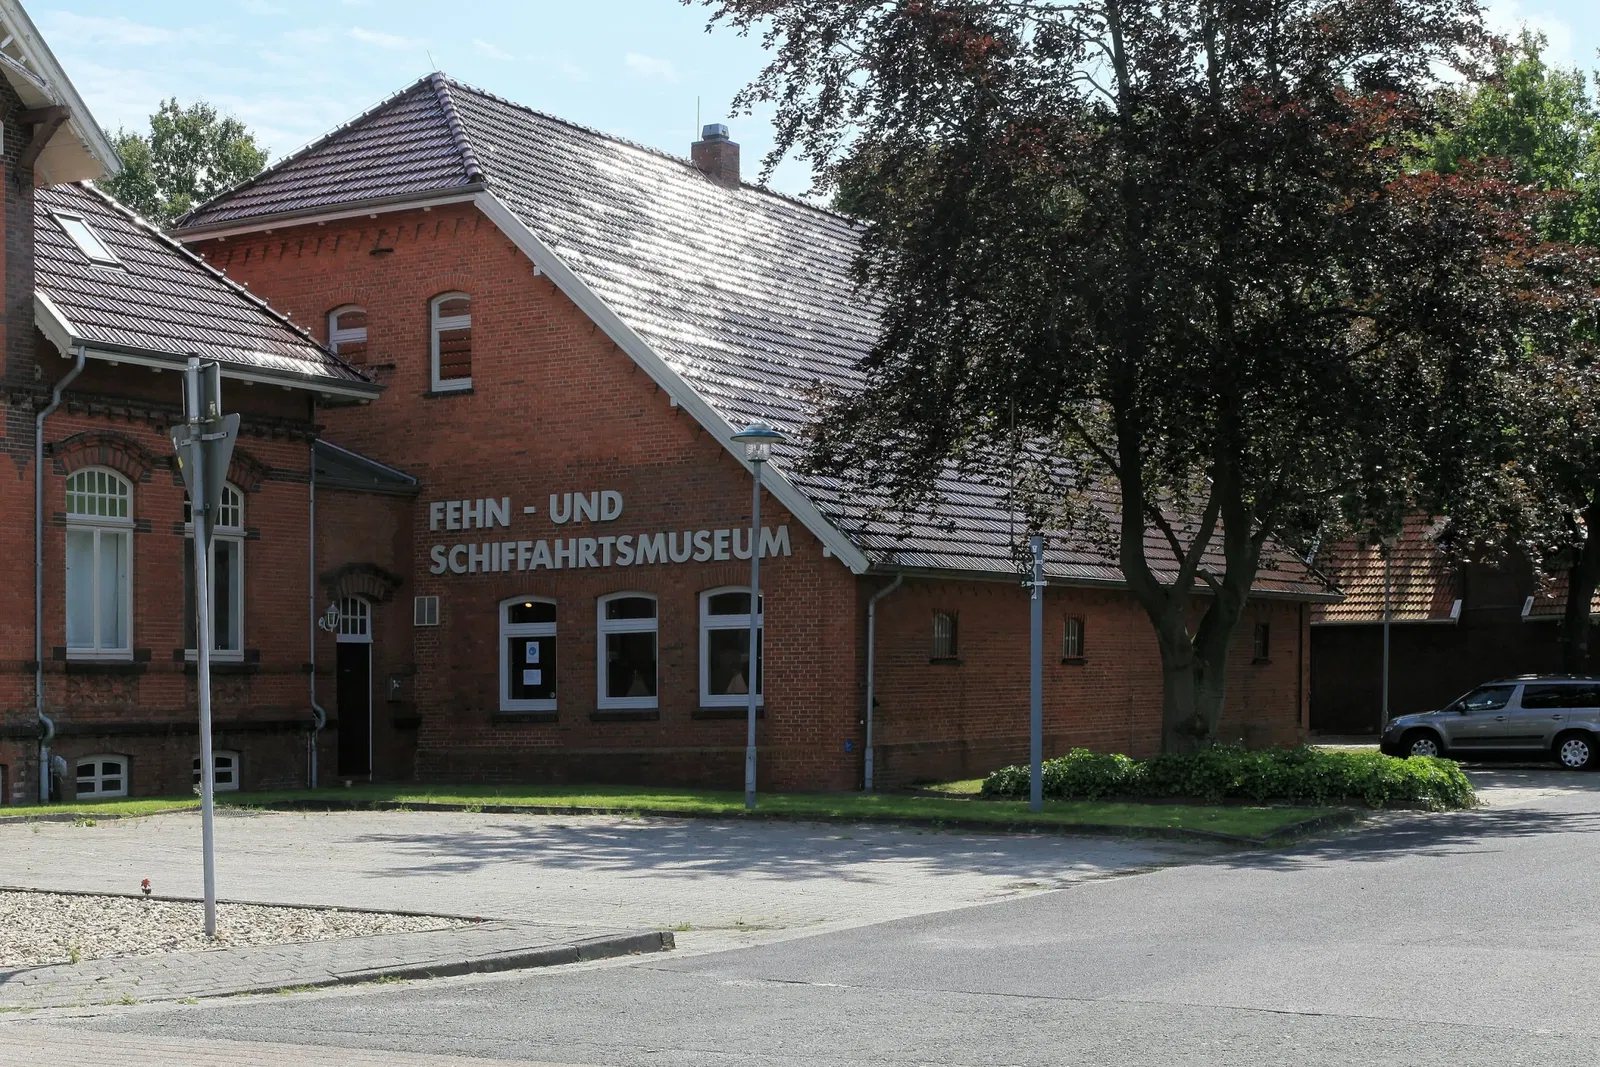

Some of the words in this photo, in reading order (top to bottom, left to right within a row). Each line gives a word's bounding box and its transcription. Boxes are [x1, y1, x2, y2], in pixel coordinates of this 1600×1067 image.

[429, 497, 511, 531] FEHN
[523, 506, 537, 514] -
[549, 490, 624, 524] UND
[429, 525, 792, 575] SCHIFFAHRTSMUSEUM
